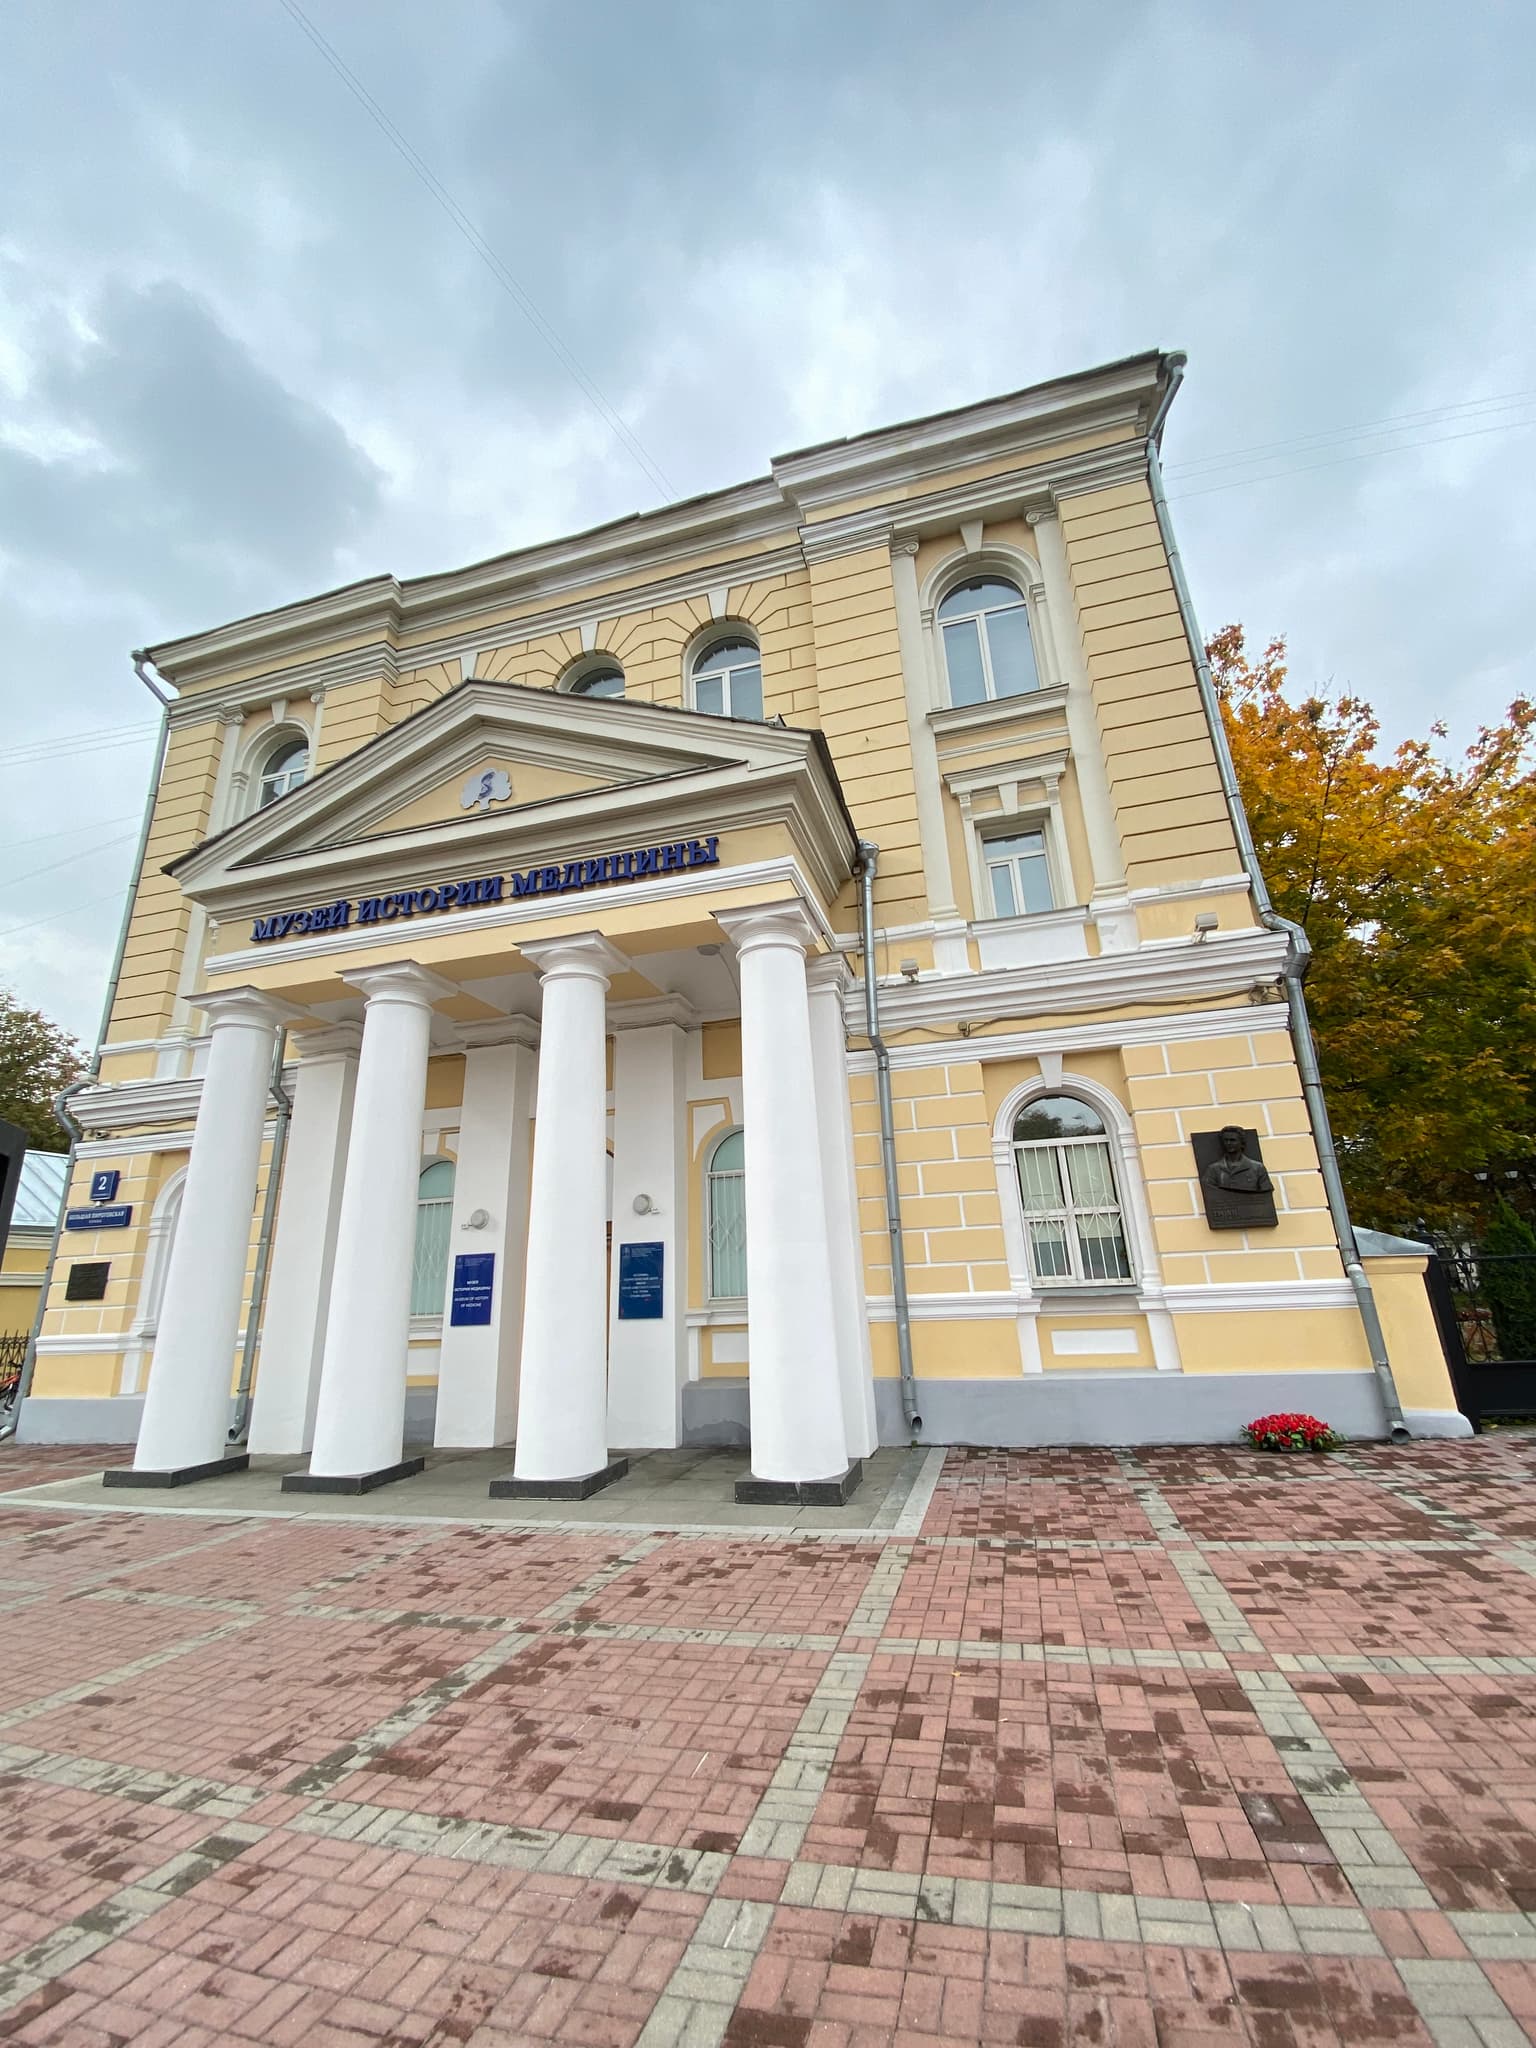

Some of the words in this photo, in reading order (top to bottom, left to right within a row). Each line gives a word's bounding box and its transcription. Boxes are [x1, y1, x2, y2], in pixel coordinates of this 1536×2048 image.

[250, 900, 351, 941] МУЗЕЙ
[357, 875, 504, 923] ИСТОРИИ
[511, 836, 719, 897] МЕДИЦИНЫ
[98, 1176, 107, 1190] 2
